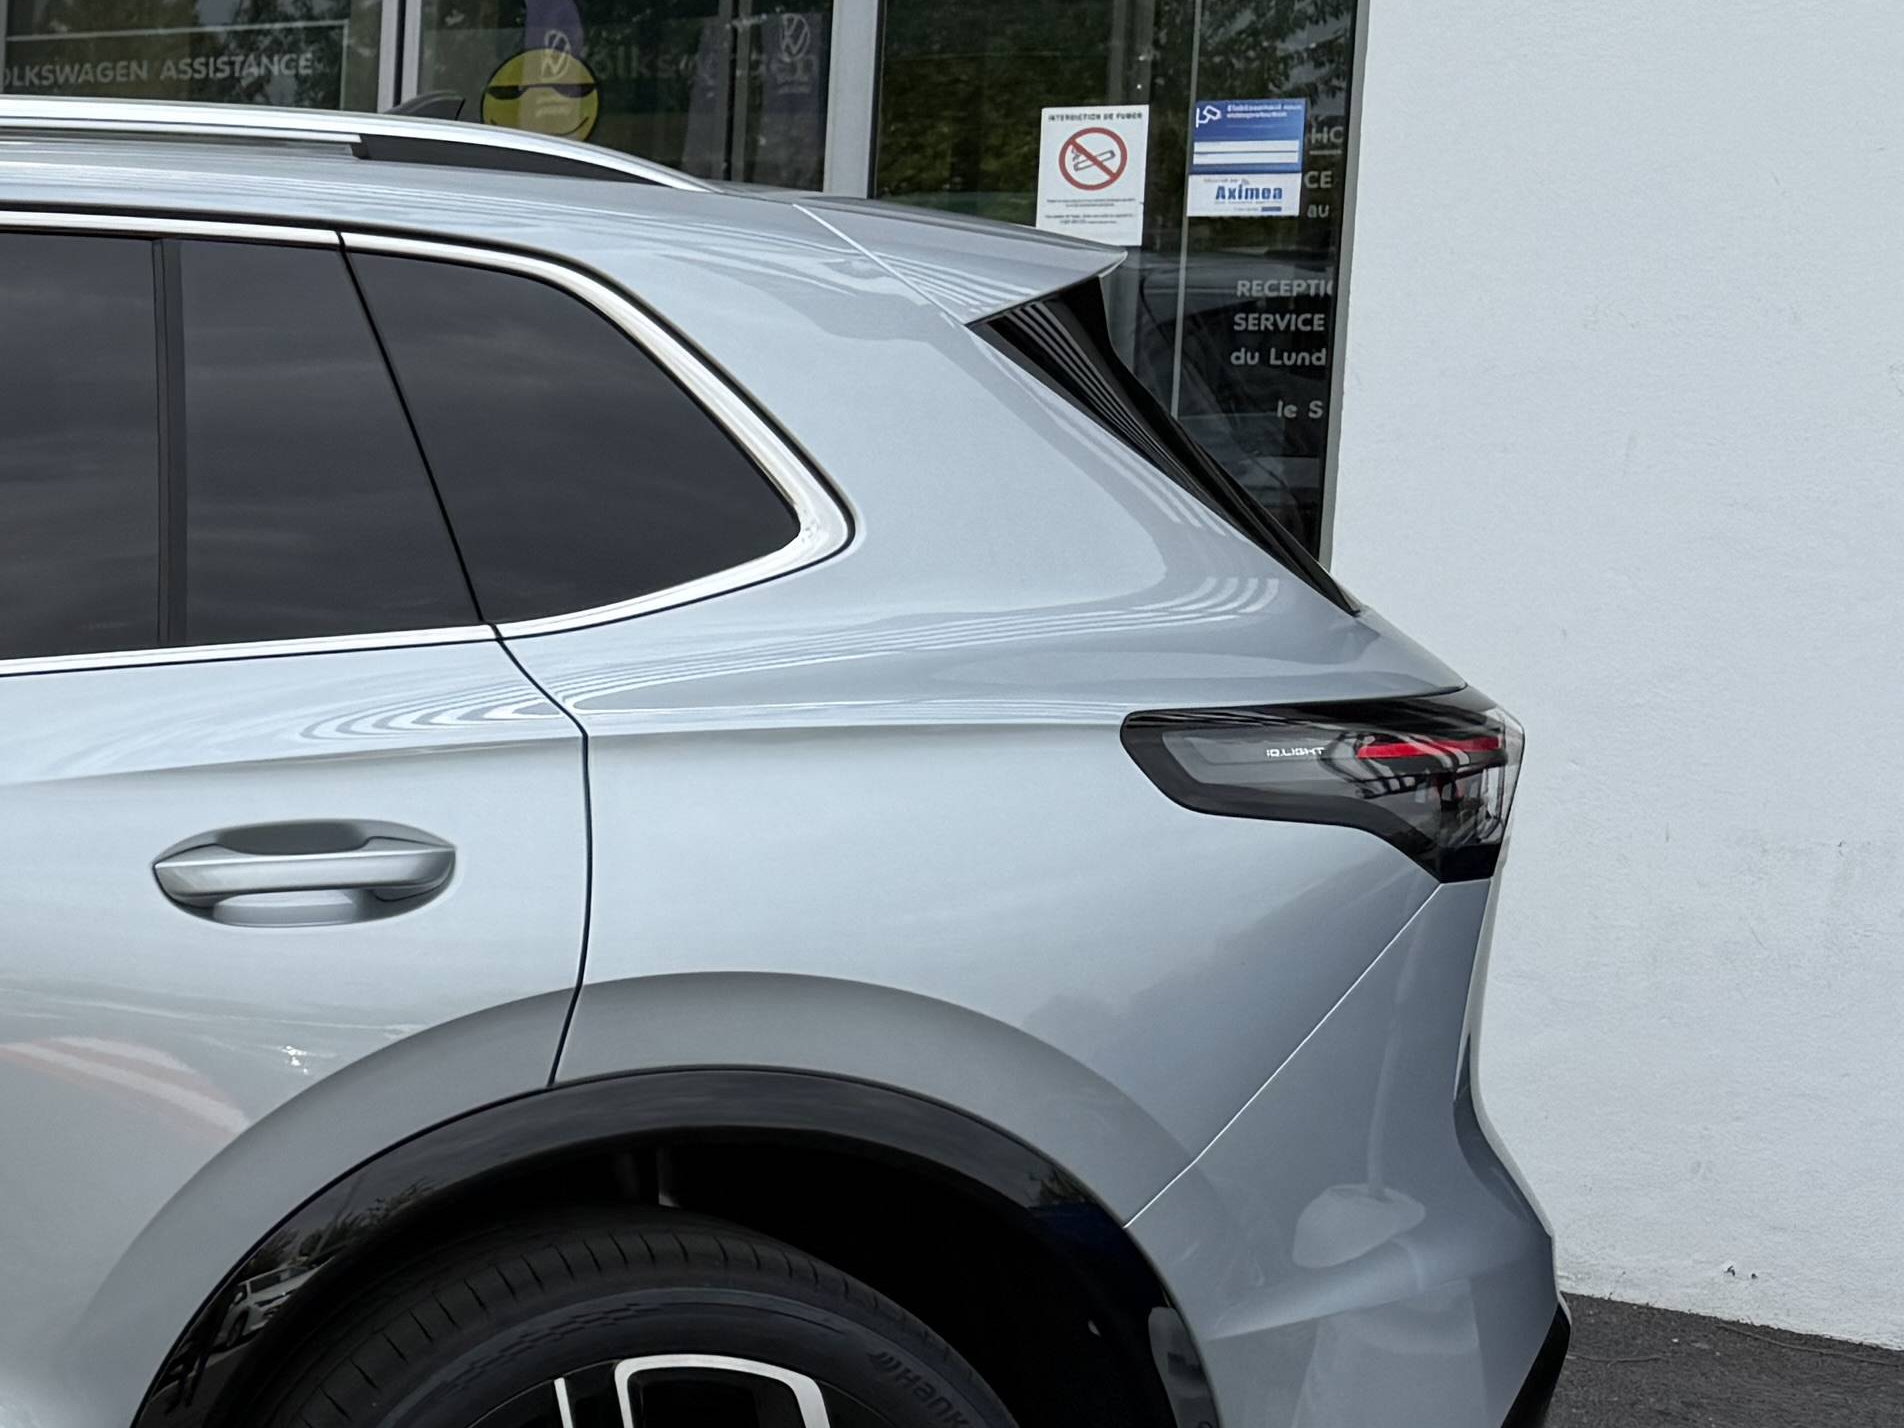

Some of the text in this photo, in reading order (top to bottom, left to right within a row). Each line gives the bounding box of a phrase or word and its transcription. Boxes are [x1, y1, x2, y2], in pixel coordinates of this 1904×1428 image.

[160, 53, 314, 80] ASSISTANCE
[1233, 313, 1325, 332] SERVICE
[1230, 347, 1259, 365] du
[1276, 399, 1298, 418] le
[1266, 746, 1325, 758] IQ.LIGHT
